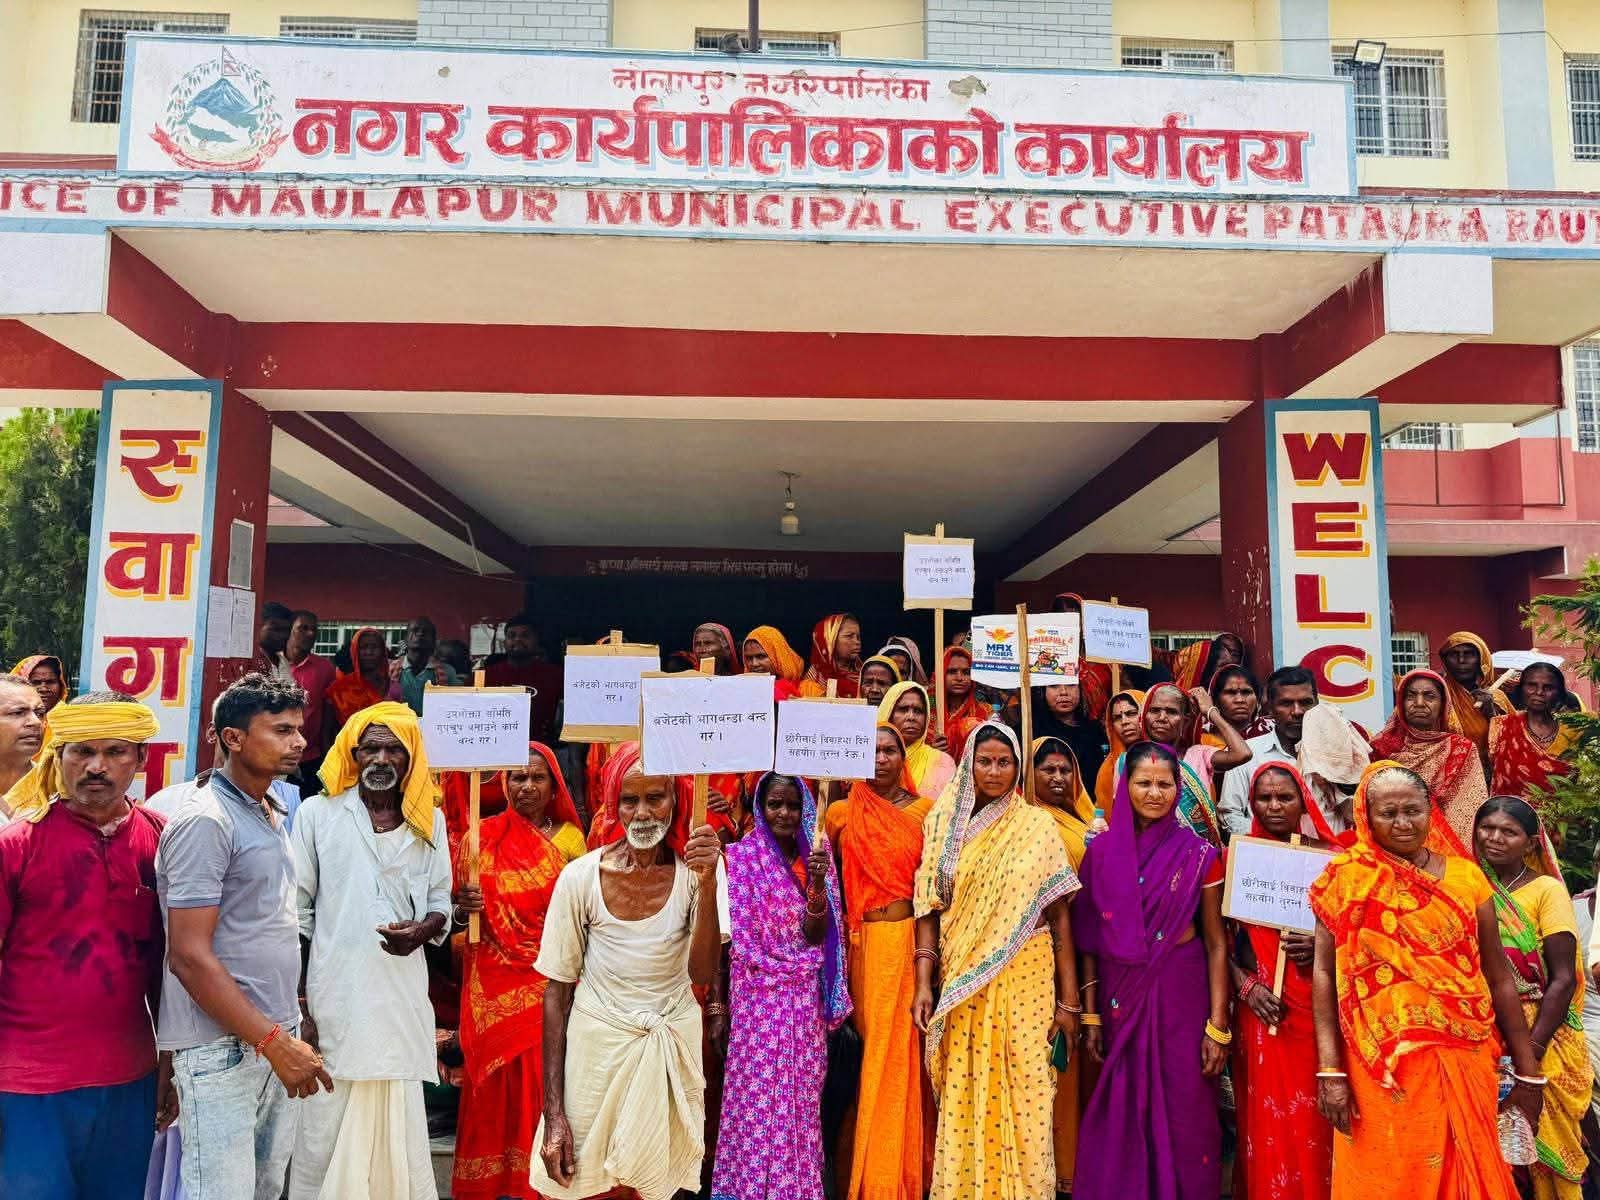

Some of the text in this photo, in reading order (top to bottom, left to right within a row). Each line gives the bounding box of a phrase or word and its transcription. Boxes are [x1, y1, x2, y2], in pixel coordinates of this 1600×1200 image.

[292, 94, 1310, 188] नगर कार्यपालिकाको कार्यालय
[116, 182, 184, 216] OF
[210, 182, 558, 224] MAULAPUR
[585, 189, 921, 232] MUNICIPAL
[944, 198, 1249, 239] EXECUTIVE
[1281, 431, 1374, 742] WELC
[986, 643, 1013, 652] MAX
[699, 731, 715, 742] गर
